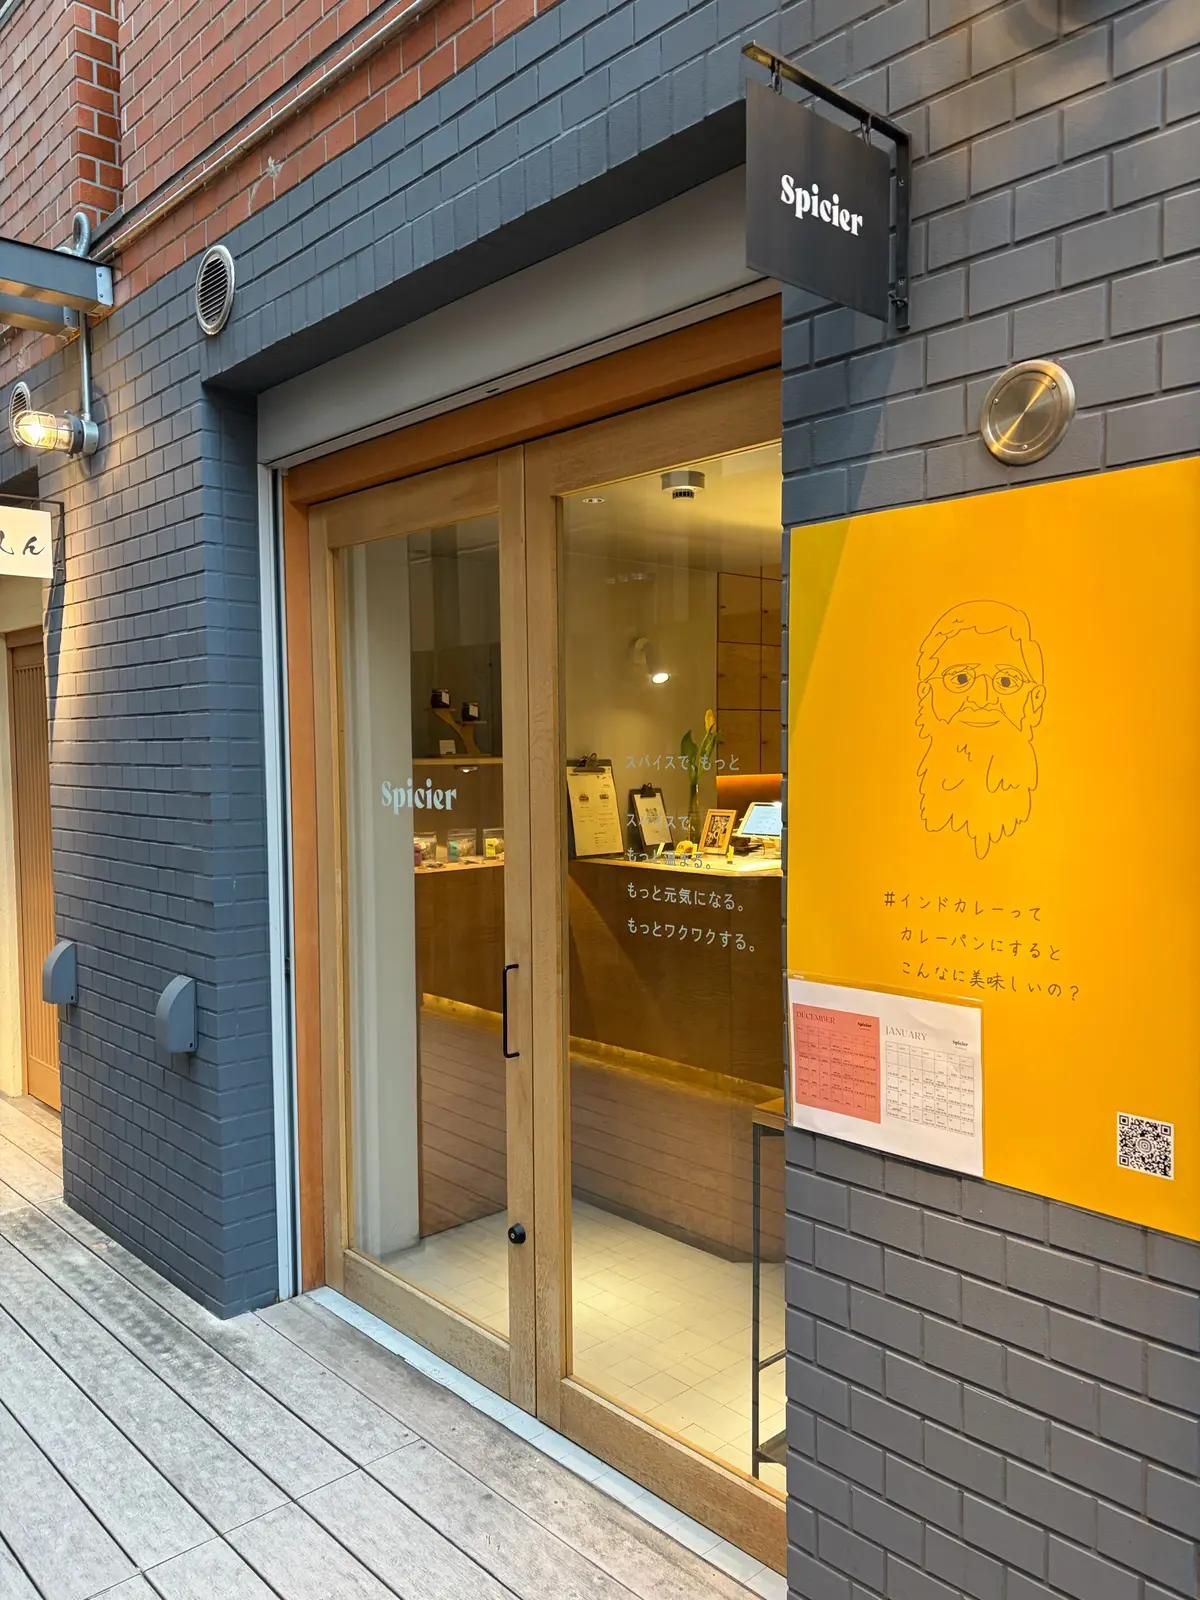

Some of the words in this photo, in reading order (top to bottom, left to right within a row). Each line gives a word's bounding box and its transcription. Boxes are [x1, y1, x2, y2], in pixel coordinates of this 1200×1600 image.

[780, 174, 863, 236] Spicier
[381, 777, 457, 815] Spicier
[627, 882, 744, 912] もっと元気になる。
[627, 917, 755, 952] もっとワクワクする。
[901, 926, 1060, 961] カレーパンにすると
[885, 1026, 928, 1041] JANUARY
